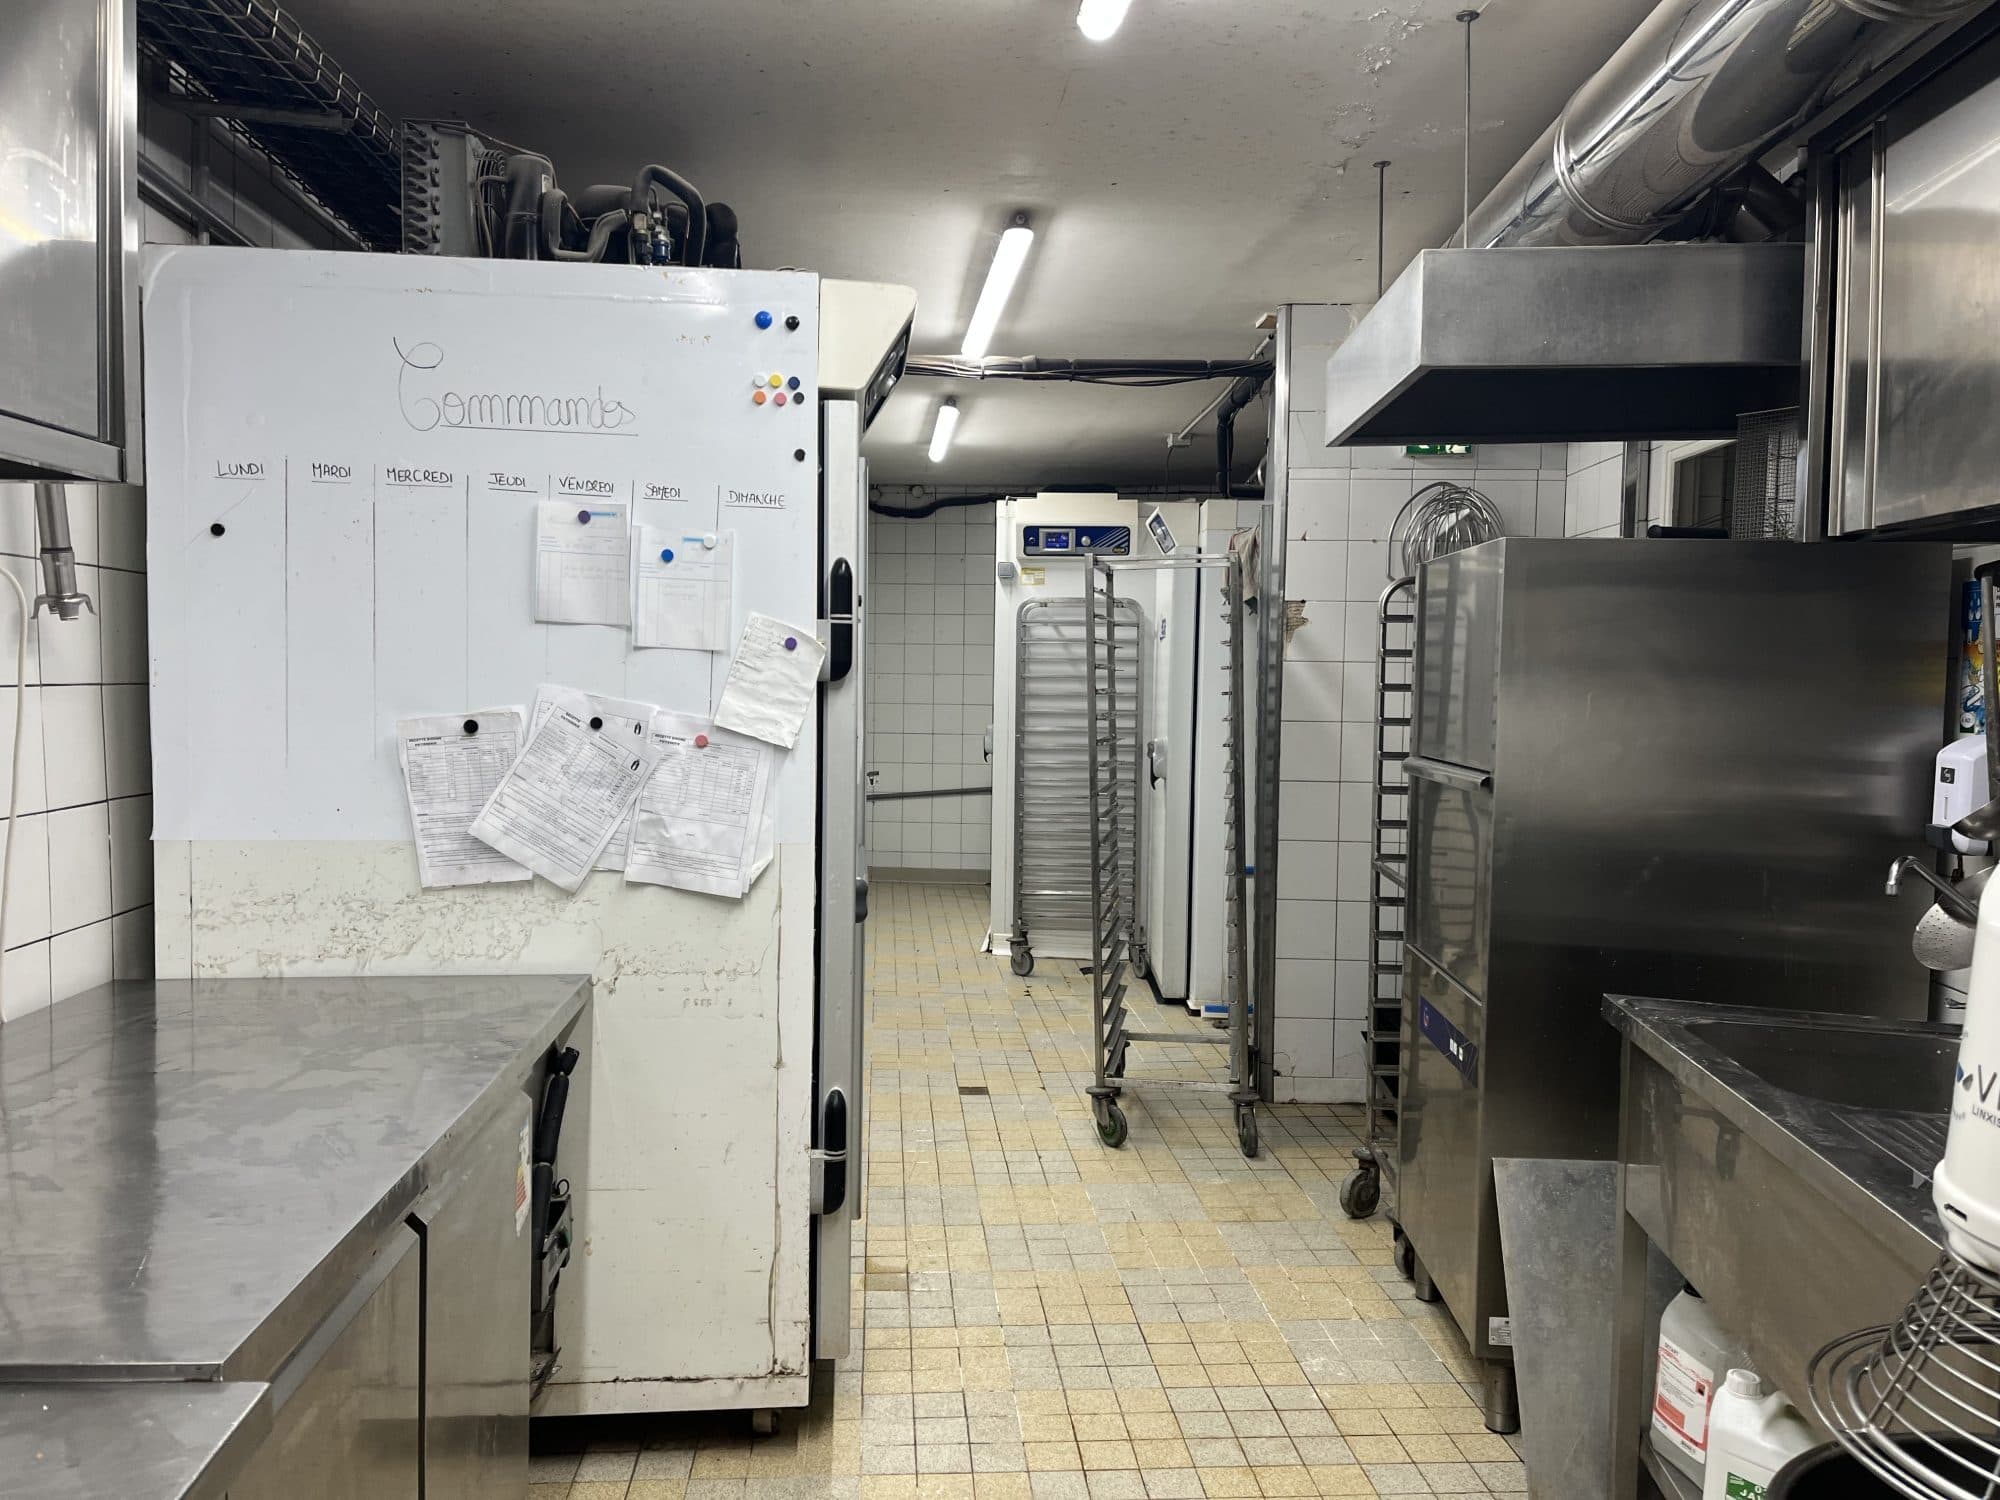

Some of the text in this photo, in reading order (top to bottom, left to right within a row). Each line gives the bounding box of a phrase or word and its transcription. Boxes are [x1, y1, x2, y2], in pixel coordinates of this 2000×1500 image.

[216, 459, 786, 507] LUNDI MARDI MERCREDI JEUDI VENDREDI SAMEDI DIMANCHE
[1977, 1063, 2000, 1112] V
